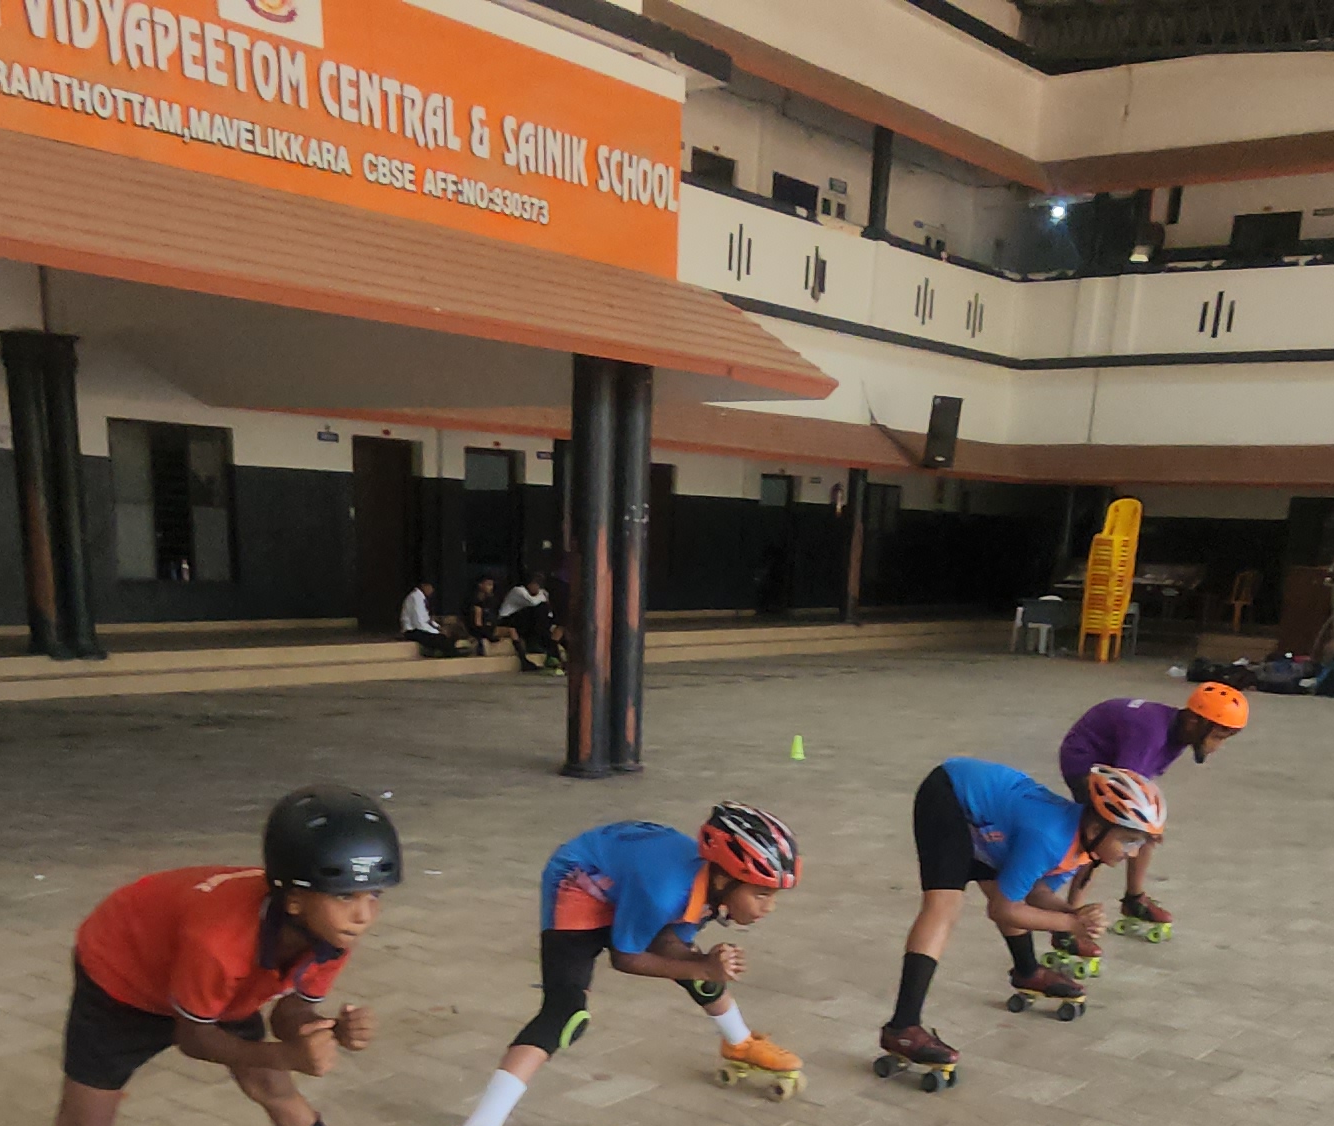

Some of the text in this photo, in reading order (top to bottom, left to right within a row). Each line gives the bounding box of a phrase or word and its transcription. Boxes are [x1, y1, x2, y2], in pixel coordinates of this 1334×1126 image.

[24, 0, 309, 109] VIDYAPEETOM
[319, 60, 462, 151] CENTRAL
[470, 105, 491, 159] &
[502, 115, 588, 187] SAINIK
[595, 145, 679, 213] SCHOOL
[362, 153, 417, 193] CBSE
